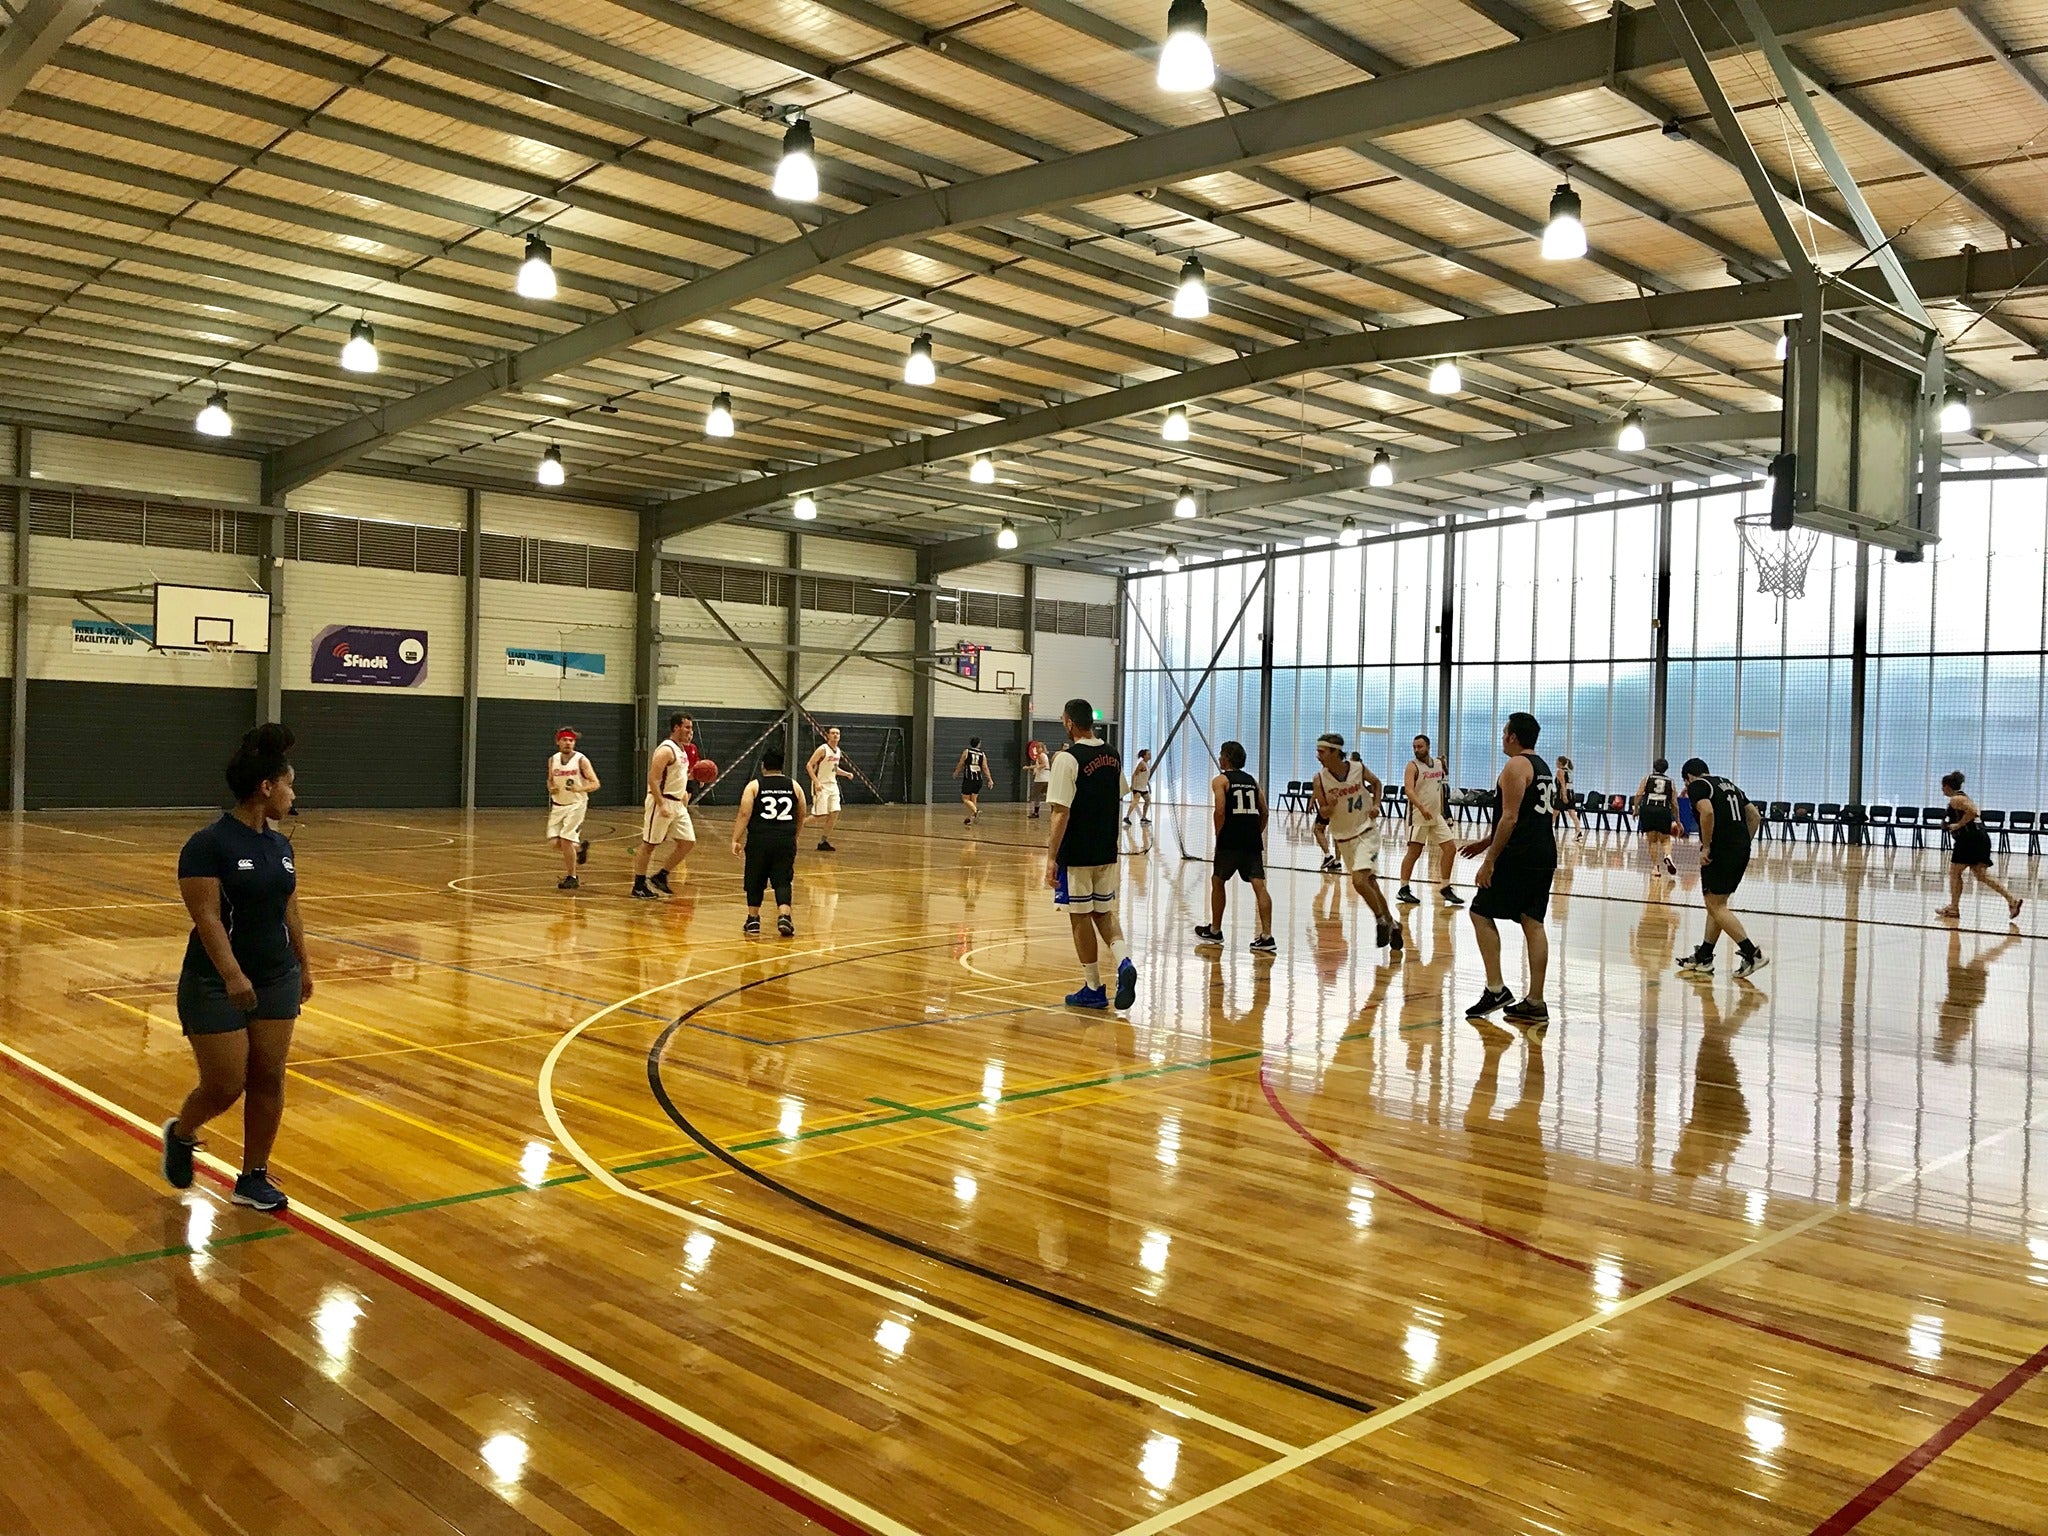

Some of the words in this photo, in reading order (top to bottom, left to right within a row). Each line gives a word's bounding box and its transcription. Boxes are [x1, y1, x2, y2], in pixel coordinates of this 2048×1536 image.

[75, 634, 109, 643] FACILITY
[110, 636, 119, 644] AT
[122, 637, 133, 645] VU
[97, 627, 103, 635] A
[760, 796, 793, 820] 32
[1232, 789, 1259, 815] 11
[1347, 795, 1362, 813] 14
[1726, 794, 1742, 822] 11
